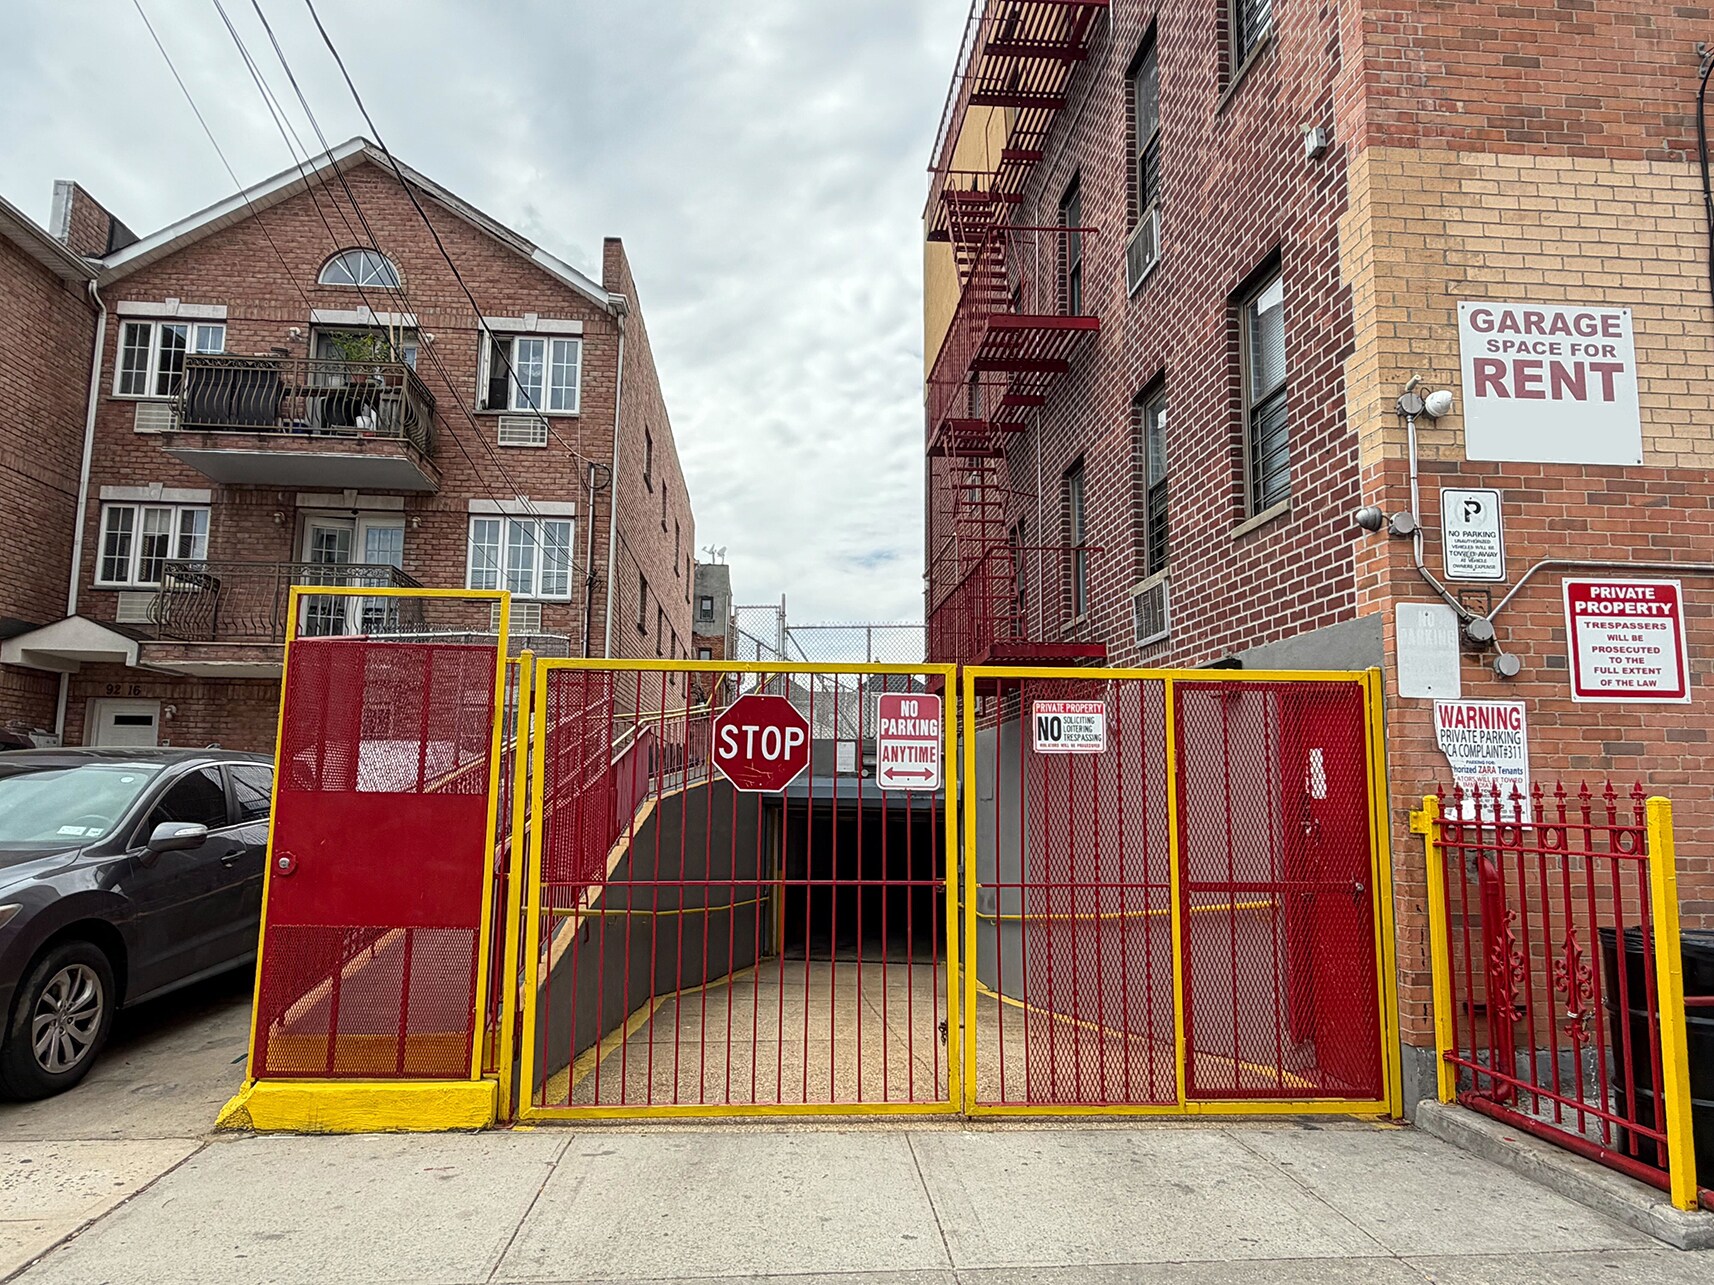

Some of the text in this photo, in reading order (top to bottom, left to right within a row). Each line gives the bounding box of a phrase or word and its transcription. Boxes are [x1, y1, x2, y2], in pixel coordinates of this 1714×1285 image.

[1469, 308, 1623, 338] GARAGE
[1486, 339, 1617, 358] SPACE FOR
[1473, 357, 1625, 402] RENT
[1590, 586, 1656, 600] PRIVATE
[1575, 600, 1673, 615] PROPERTY
[1584, 621, 1667, 631] TRESPASSERS
[1606, 634, 1644, 642] WILL BE
[1591, 645, 1661, 655] PROSECUTED
[1608, 656, 1645, 665] TO THE
[1593, 666, 1662, 676] FULL EXTENT
[106, 683, 141, 696] 92 16
[1600, 679, 1657, 688] OF THE LAW
[900, 699, 919, 718] NO
[1035, 703, 1102, 713] PRIVATE PROPERTY
[1062, 716, 1095, 725] SOLICITING
[1438, 704, 1521, 731] WARNING
[880, 718, 938, 737] PARKING
[1037, 715, 1062, 742] NO
[1063, 724, 1093, 733] LOITERING
[718, 724, 805, 761] STOP
[1063, 733, 1102, 742] TRESPASSING
[1440, 728, 1521, 745] PRIVATE PARKING
[882, 745, 937, 763] ANYTIME
[1478, 765, 1497, 774] ZARA
[1498, 766, 1523, 775] Tenants
